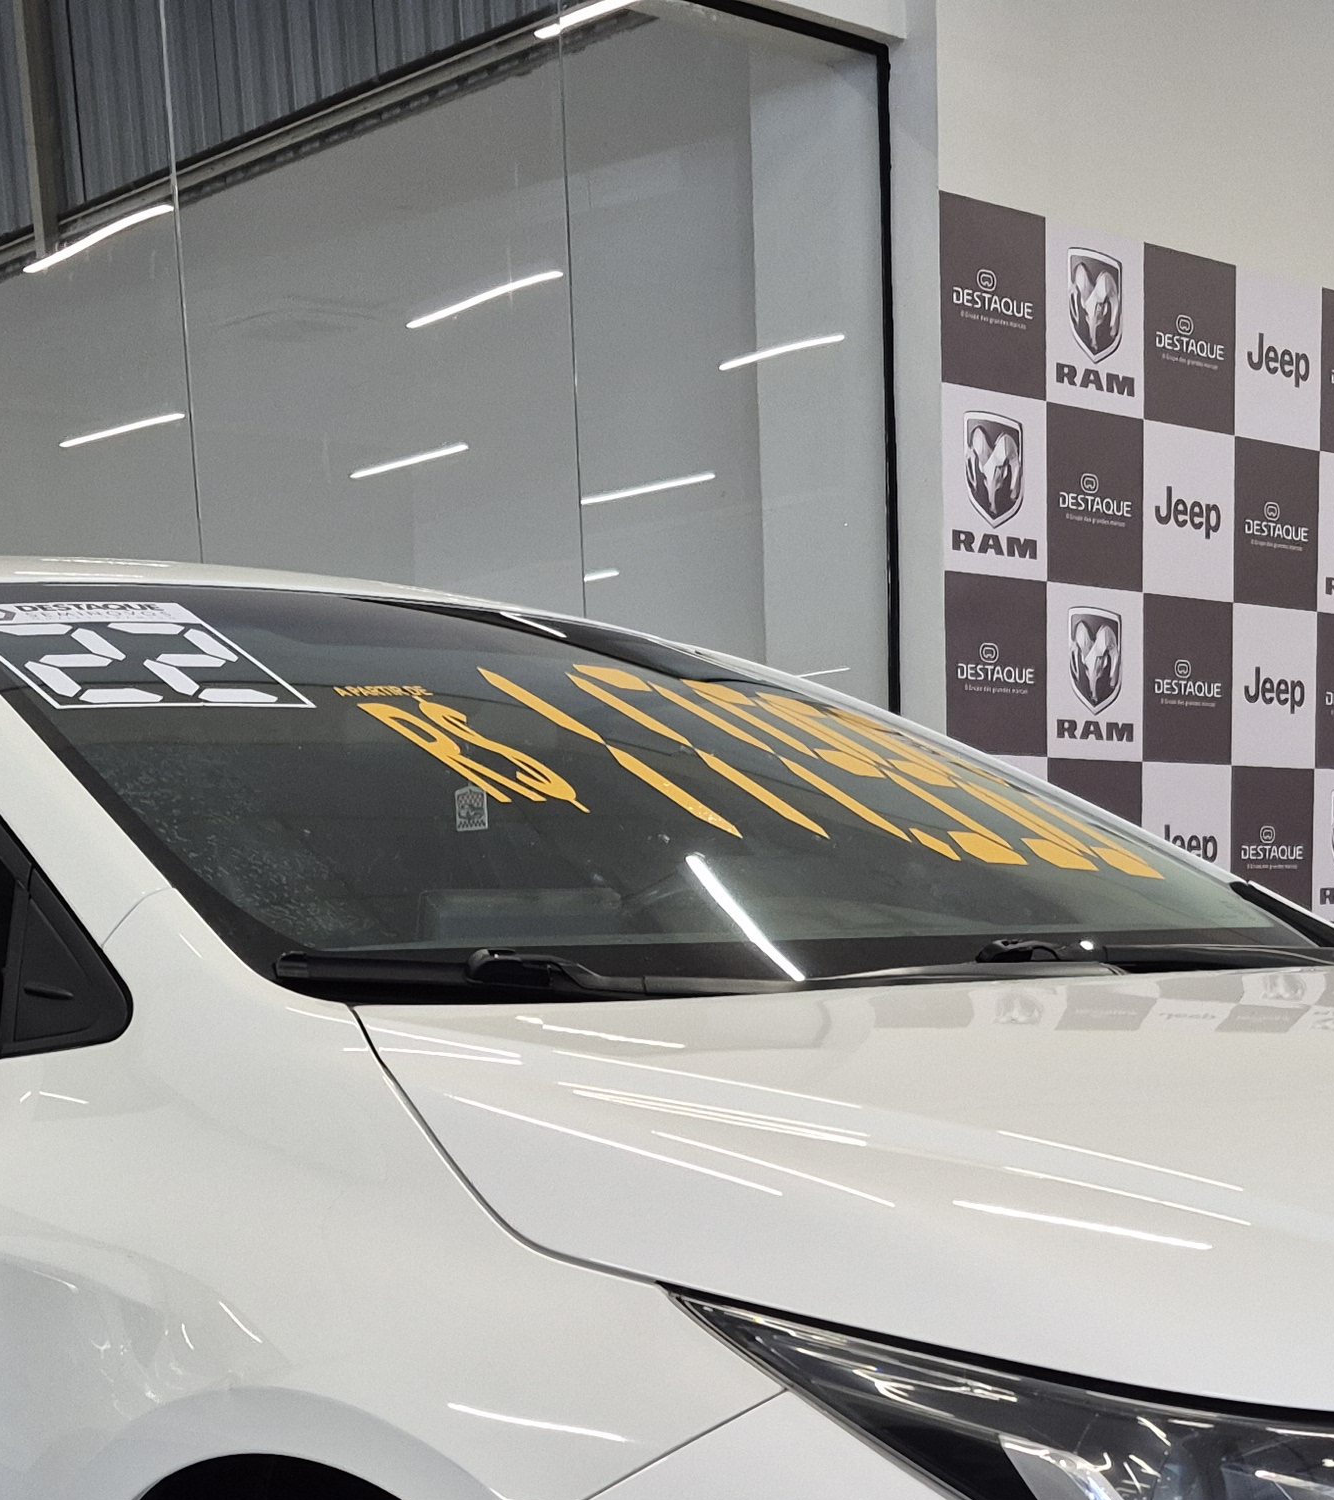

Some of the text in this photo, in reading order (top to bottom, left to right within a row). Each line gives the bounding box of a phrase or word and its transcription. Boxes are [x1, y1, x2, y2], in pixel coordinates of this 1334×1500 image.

[953, 287, 1033, 321] DESTAQUE
[1156, 331, 1225, 361] DESTAQUE
[1247, 332, 1310, 388] Jeep
[1056, 362, 1135, 397] RAM
[1059, 491, 1132, 520] DESTAQUE
[1155, 486, 1221, 540] Jeep
[952, 529, 1037, 559] RAM
[1244, 518, 1309, 546] DESTAQUE
[16, 603, 165, 612] DESTAQUE
[957, 662, 1034, 684] DESTAQUE
[334, 685, 434, 697] A PARTIR DE
[1154, 678, 1222, 698] DESTAQUE
[1244, 666, 1305, 714] Jeep
[1057, 719, 1134, 742] RAM
[357, 696, 591, 814] R$
[1240, 844, 1304, 860] DESTAQUE
